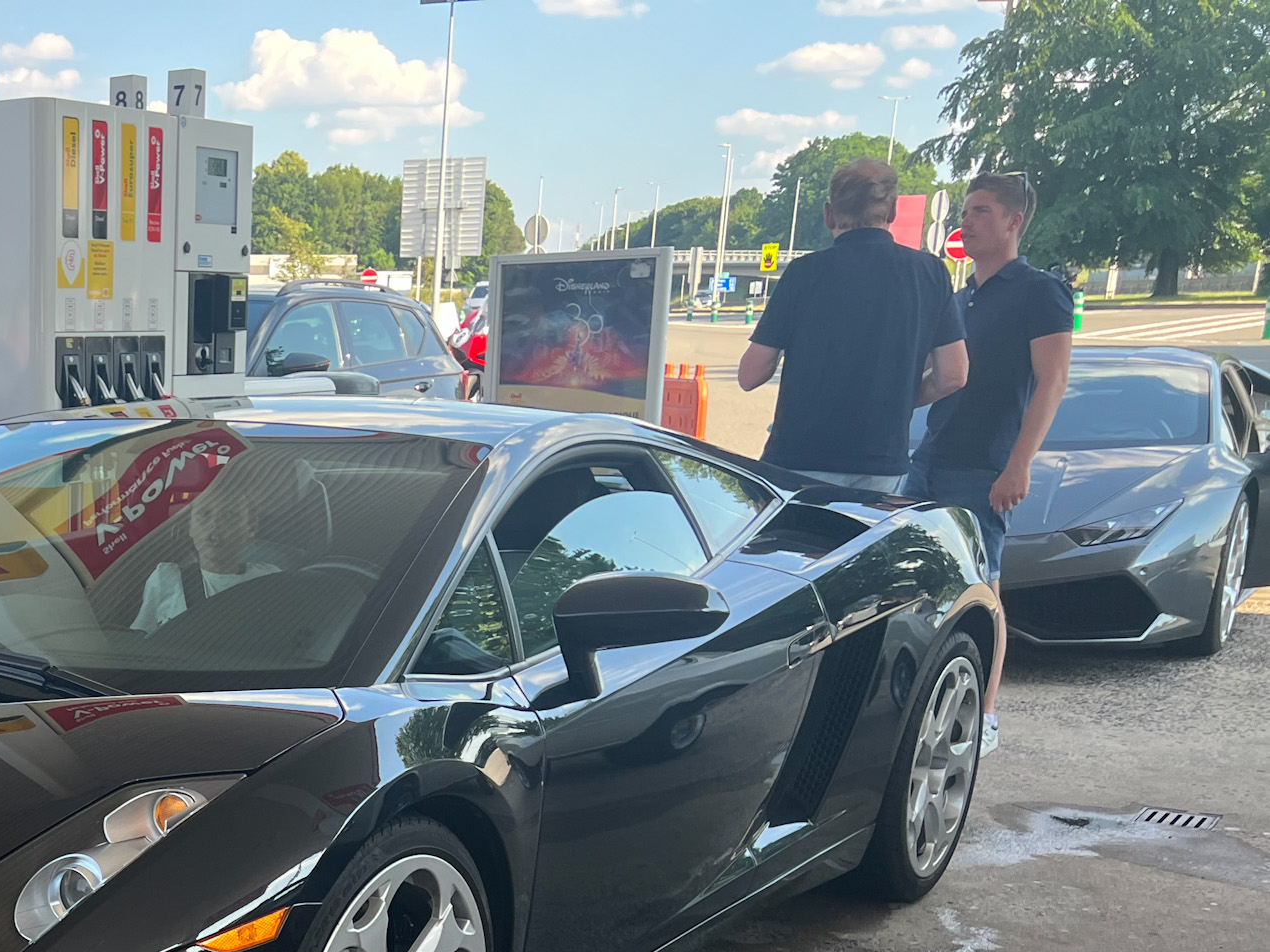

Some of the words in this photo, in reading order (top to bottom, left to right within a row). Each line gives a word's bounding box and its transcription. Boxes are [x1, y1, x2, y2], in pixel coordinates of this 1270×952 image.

[115, 91, 127, 107] 8
[135, 90, 144, 109] 8
[173, 84, 185, 107] 7
[194, 84, 203, 106] 7
